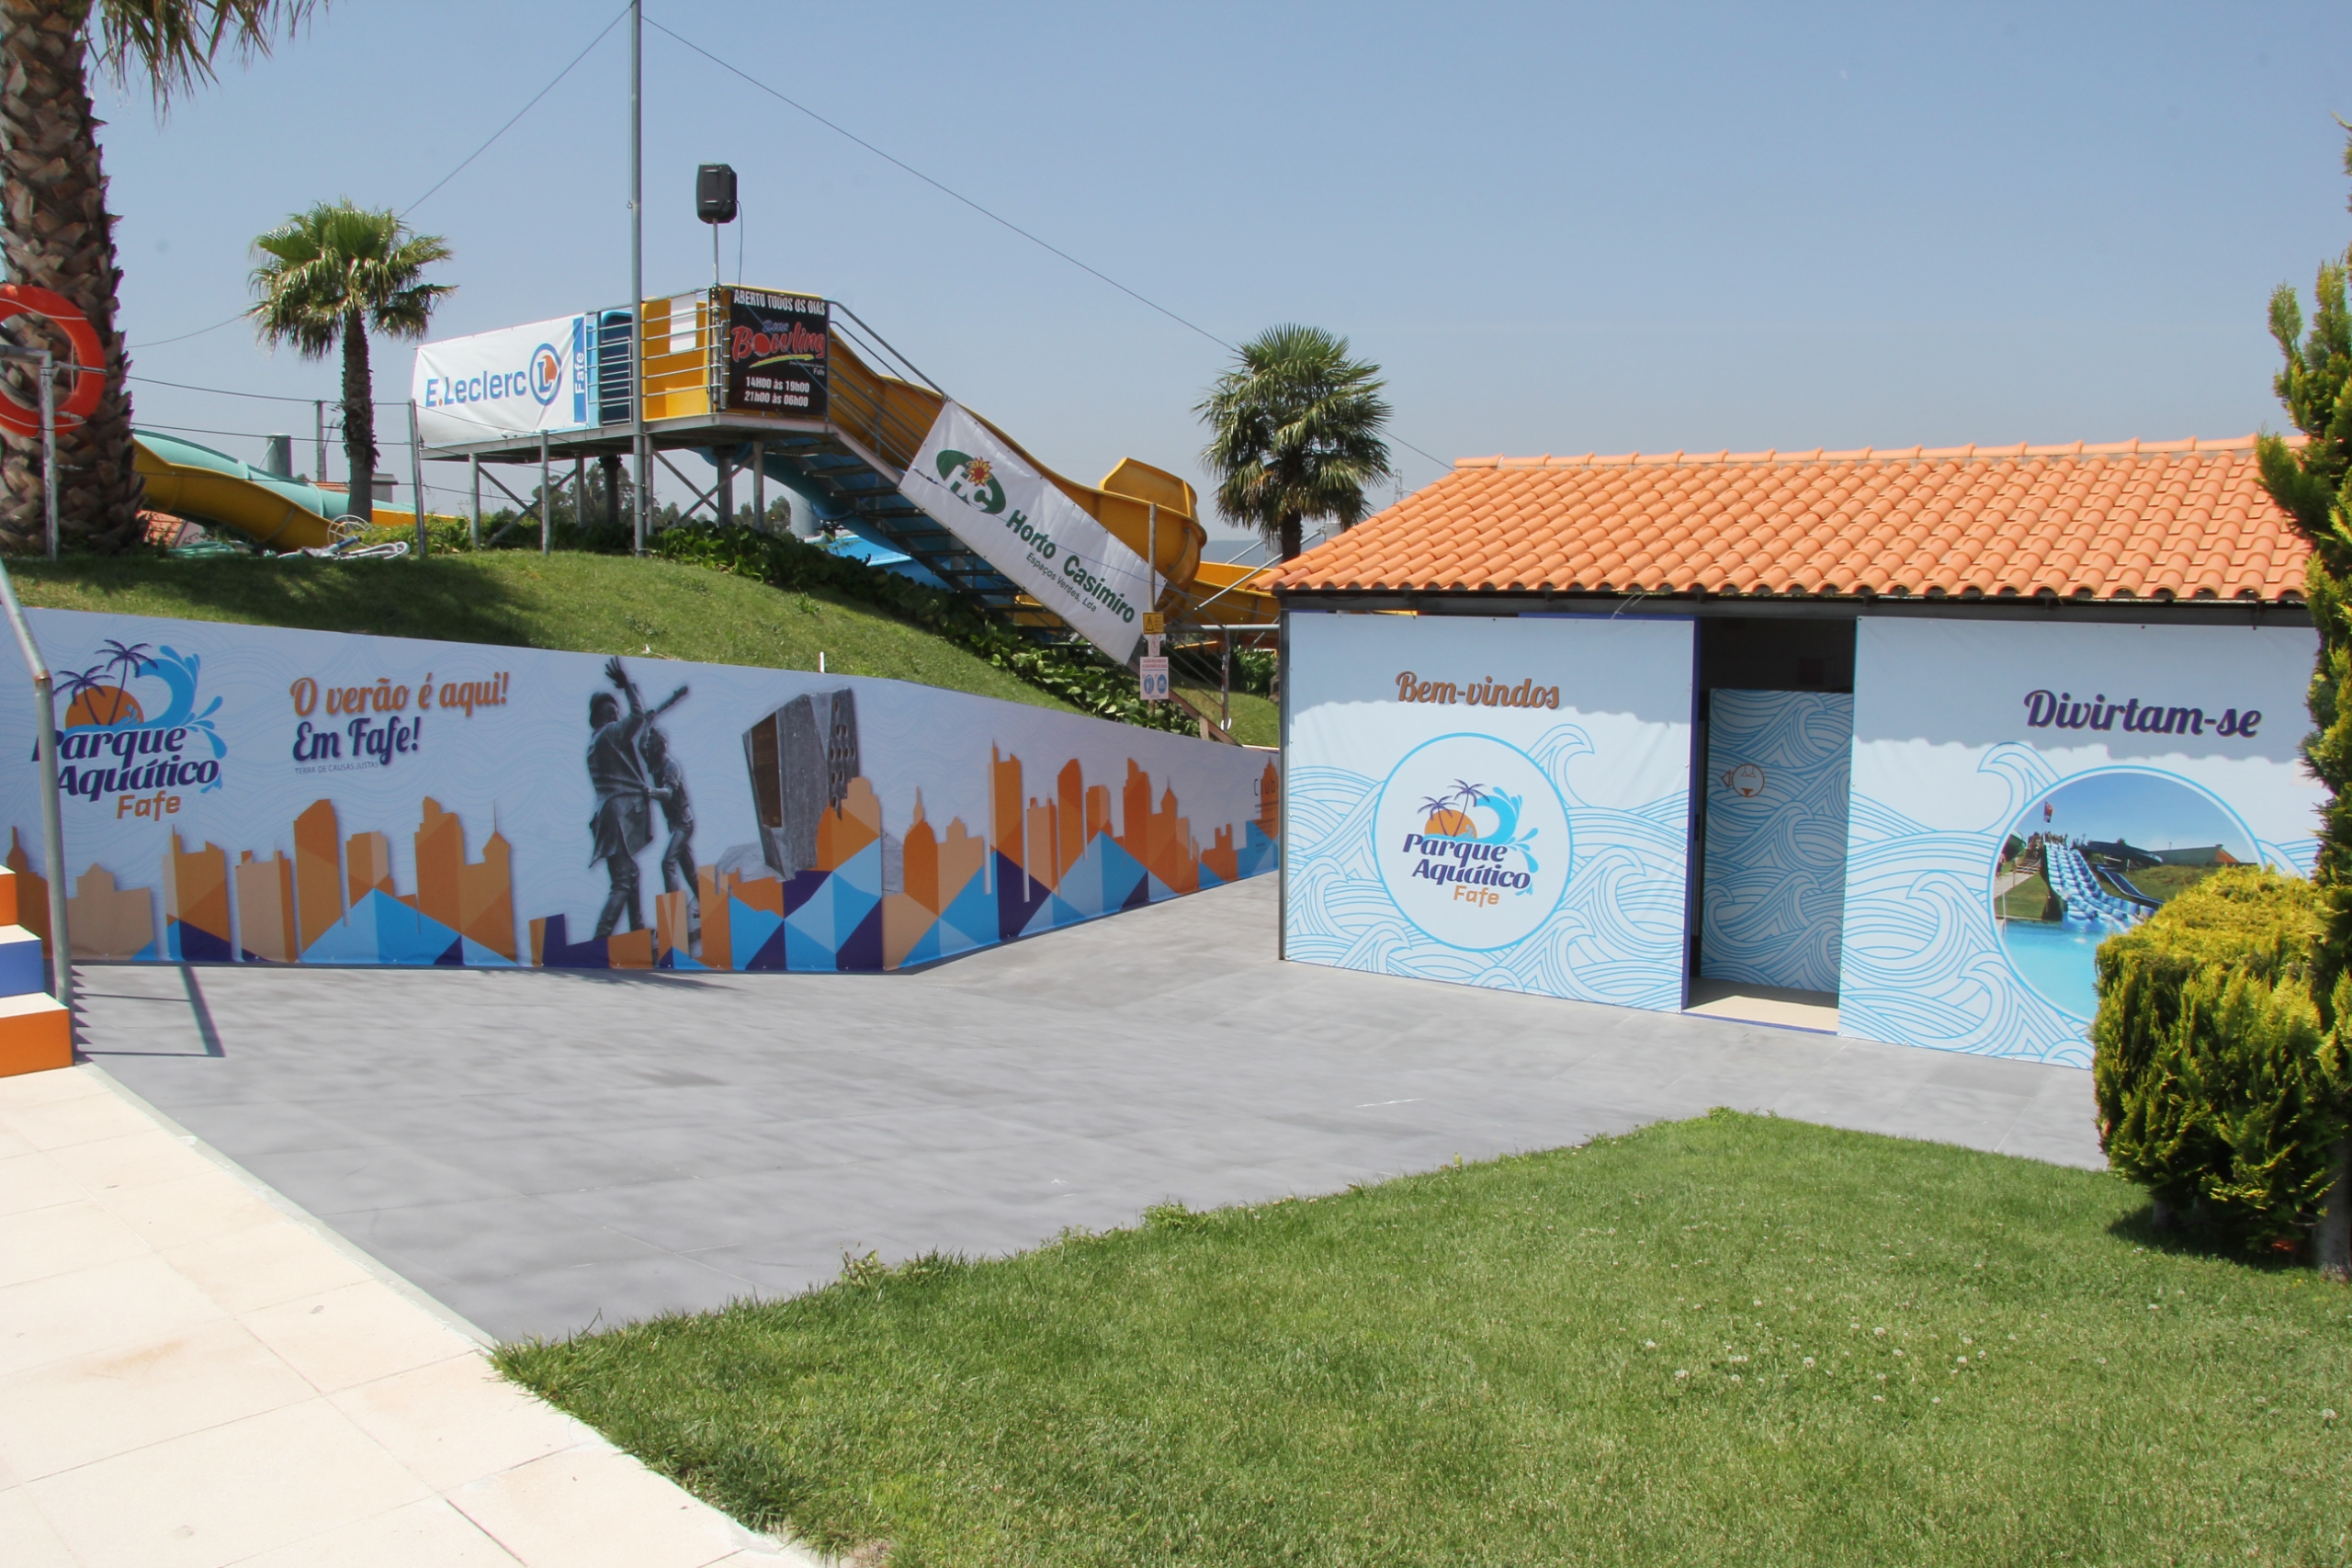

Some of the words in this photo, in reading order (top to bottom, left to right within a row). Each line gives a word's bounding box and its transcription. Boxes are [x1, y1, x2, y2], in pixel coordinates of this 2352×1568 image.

[734, 289, 765, 307] ABERTO
[767, 294, 792, 312] TODOS
[795, 299, 806, 313] OS
[808, 300, 825, 315] DIAS
[731, 321, 826, 363] Bowling
[762, 320, 789, 333] Zona
[425, 371, 527, 407] E.Leclerc
[575, 352, 585, 394] Fafe
[745, 377, 772, 389] 14H00
[774, 378, 783, 390] às
[786, 380, 809, 393] 19h00
[814, 367, 825, 376] Fafe
[744, 390, 770, 403] 21h00
[772, 393, 782, 404] às
[784, 394, 808, 407] 06h00
[1005, 509, 1057, 559] Horto
[1063, 555, 1135, 624] Casimiro
[1026, 552, 1057, 581] Espaços
[1057, 576, 1080, 603] Verdes,
[1082, 597, 1097, 612] Lda
[290, 677, 317, 716] O
[326, 678, 410, 715] verão
[418, 672, 433, 709] é
[439, 671, 509, 717] aqui!
[1395, 671, 1559, 709] Bem-vindos
[2023, 689, 2262, 739] Divirtam-se
[292, 721, 341, 761] Em
[348, 716, 421, 765] Fafe!
[58, 754, 220, 802] Aquático
[295, 767, 316, 775] TERRA
[318, 765, 327, 773] DE
[328, 763, 355, 773] CAUSAS
[356, 761, 379, 770] JUSTAS
[117, 790, 181, 821] Fafe
[1402, 833, 1508, 868] Parque
[1411, 858, 1531, 889] Aquático
[1453, 885, 1499, 908] Fafe
